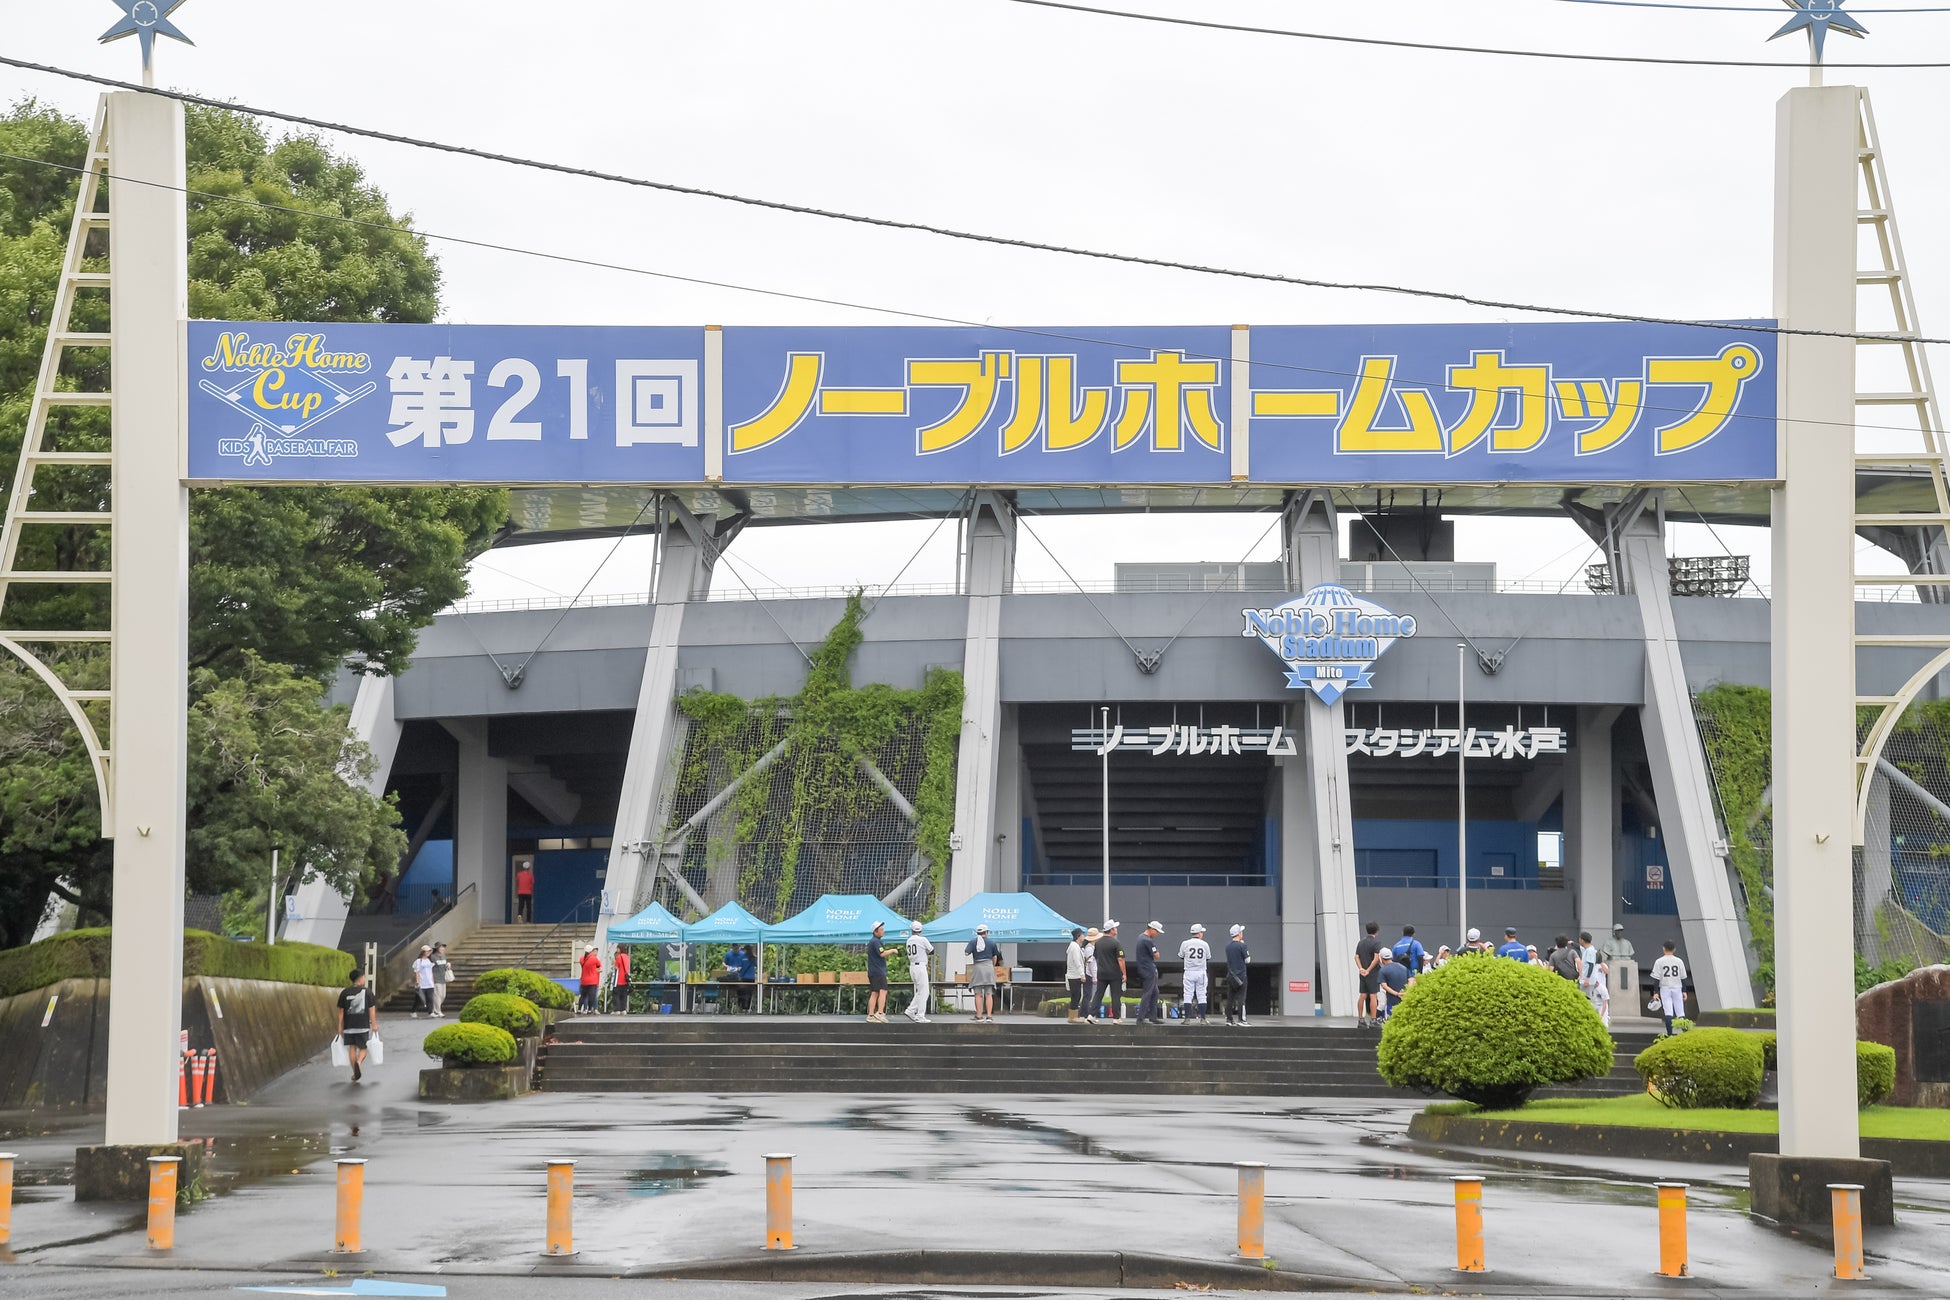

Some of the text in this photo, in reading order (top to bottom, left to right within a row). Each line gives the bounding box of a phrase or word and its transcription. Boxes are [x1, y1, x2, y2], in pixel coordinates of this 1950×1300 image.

[204, 334, 367, 368] Noble Home
[253, 368, 322, 418] Cup
[385, 342, 1763, 458] 第21回 ノーブルホームカップ
[222, 442, 355, 453] KIDS BASEBALL FAIR
[1243, 609, 1416, 637] Noble Home
[1283, 635, 1376, 659] Stadium
[1316, 666, 1343, 678] Mito
[1096, 724, 1561, 759] ノーブルホーム スタジアム水戸
[1189, 947, 1204, 959] 29
[1662, 965, 1679, 977] 28
